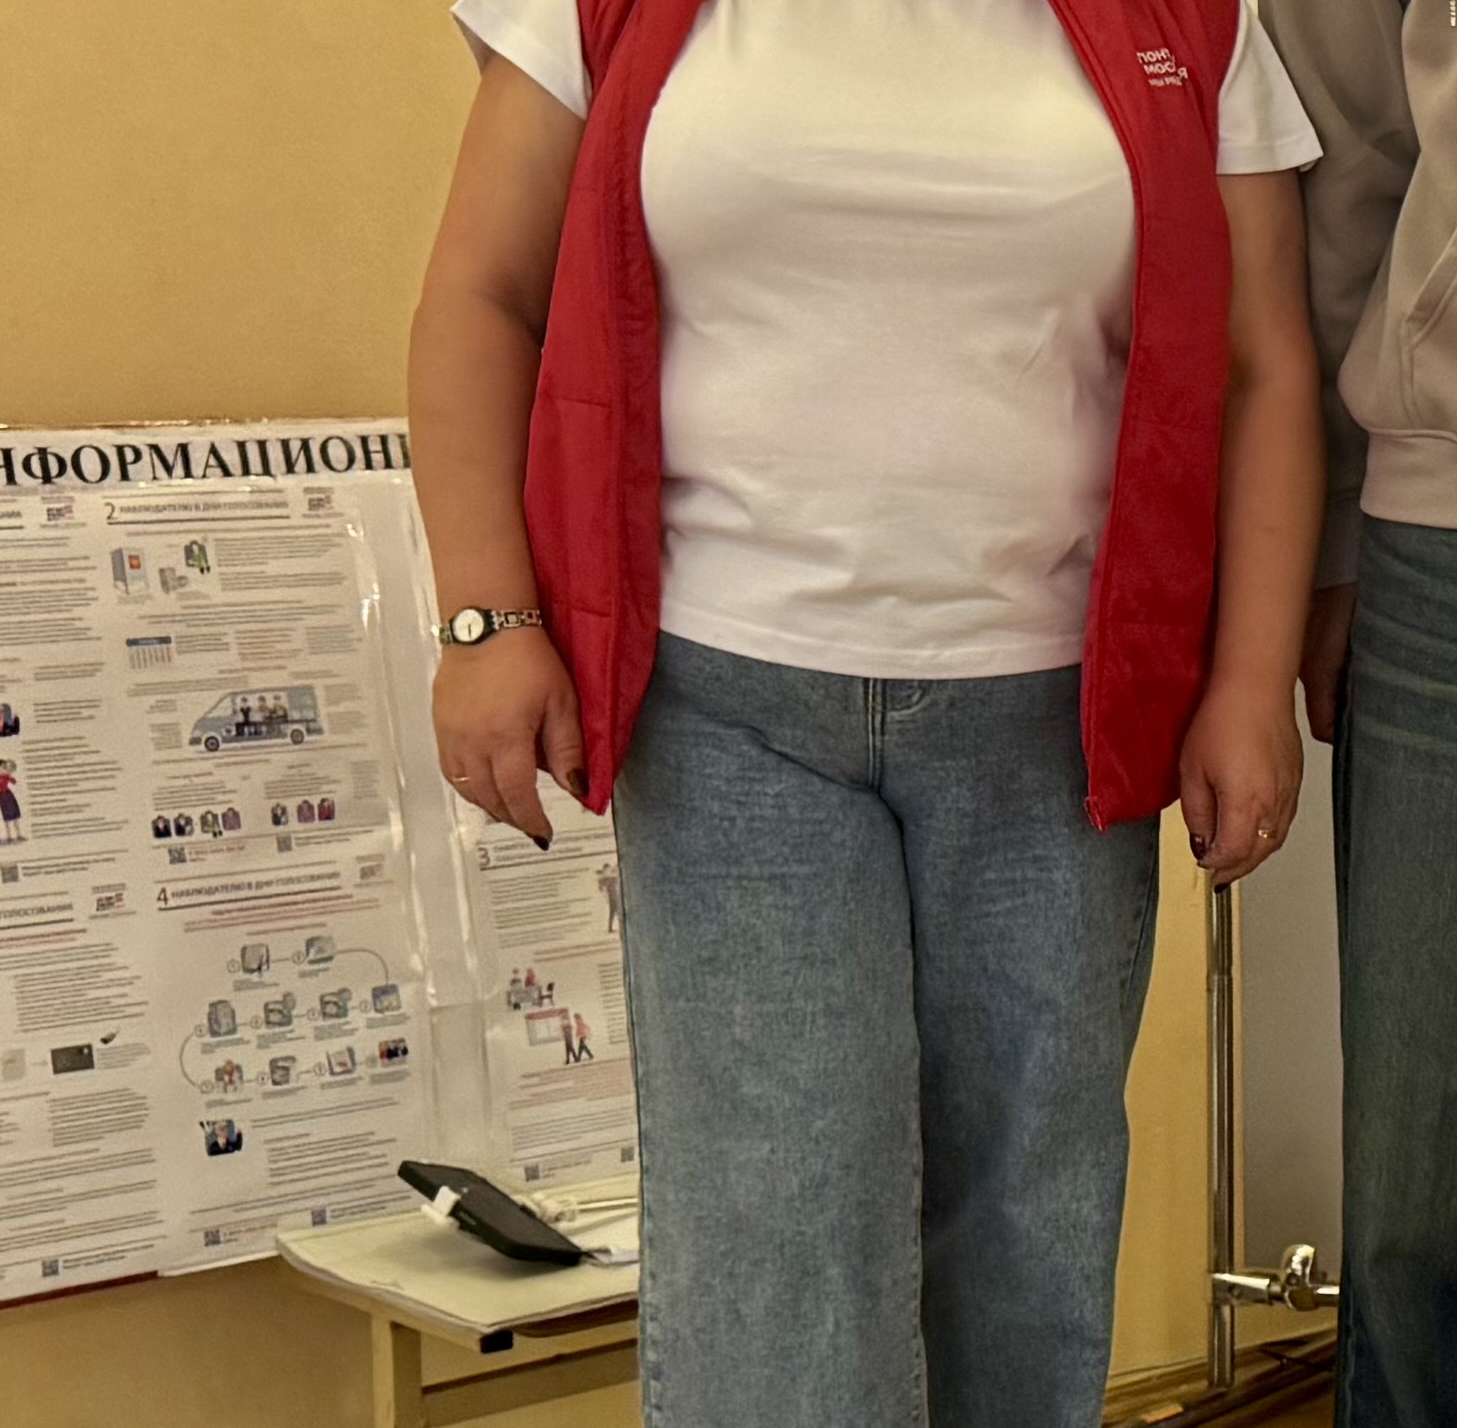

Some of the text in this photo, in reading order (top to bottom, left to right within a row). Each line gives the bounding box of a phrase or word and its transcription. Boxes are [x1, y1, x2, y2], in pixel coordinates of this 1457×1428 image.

[0, 434, 411, 486] ФОРМАЦИОН
[104, 502, 116, 520] 2
[157, 887, 169, 905] 4
